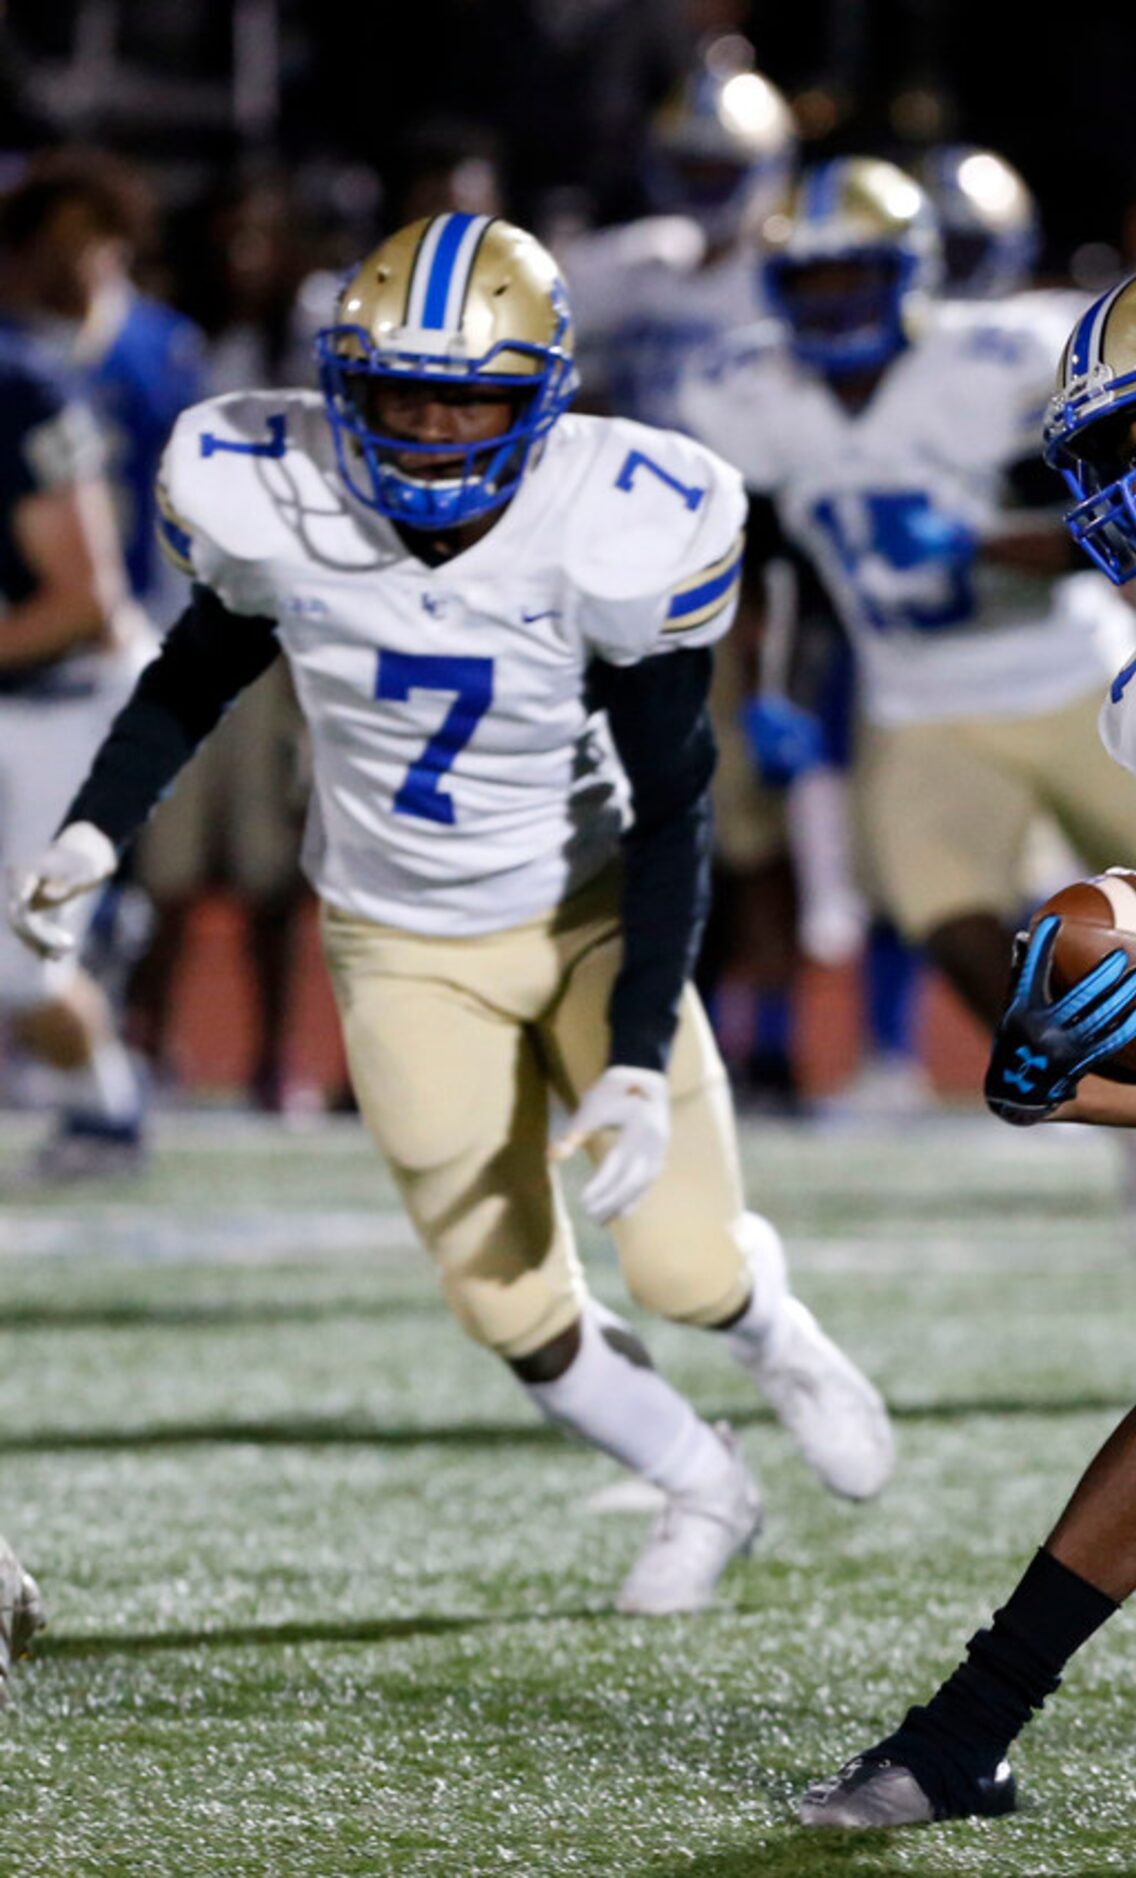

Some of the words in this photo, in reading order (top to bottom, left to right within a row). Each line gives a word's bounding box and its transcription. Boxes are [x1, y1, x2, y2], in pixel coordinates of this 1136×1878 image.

[199, 413, 286, 459] 7
[615, 448, 704, 512] 7
[375, 650, 494, 825] 7
